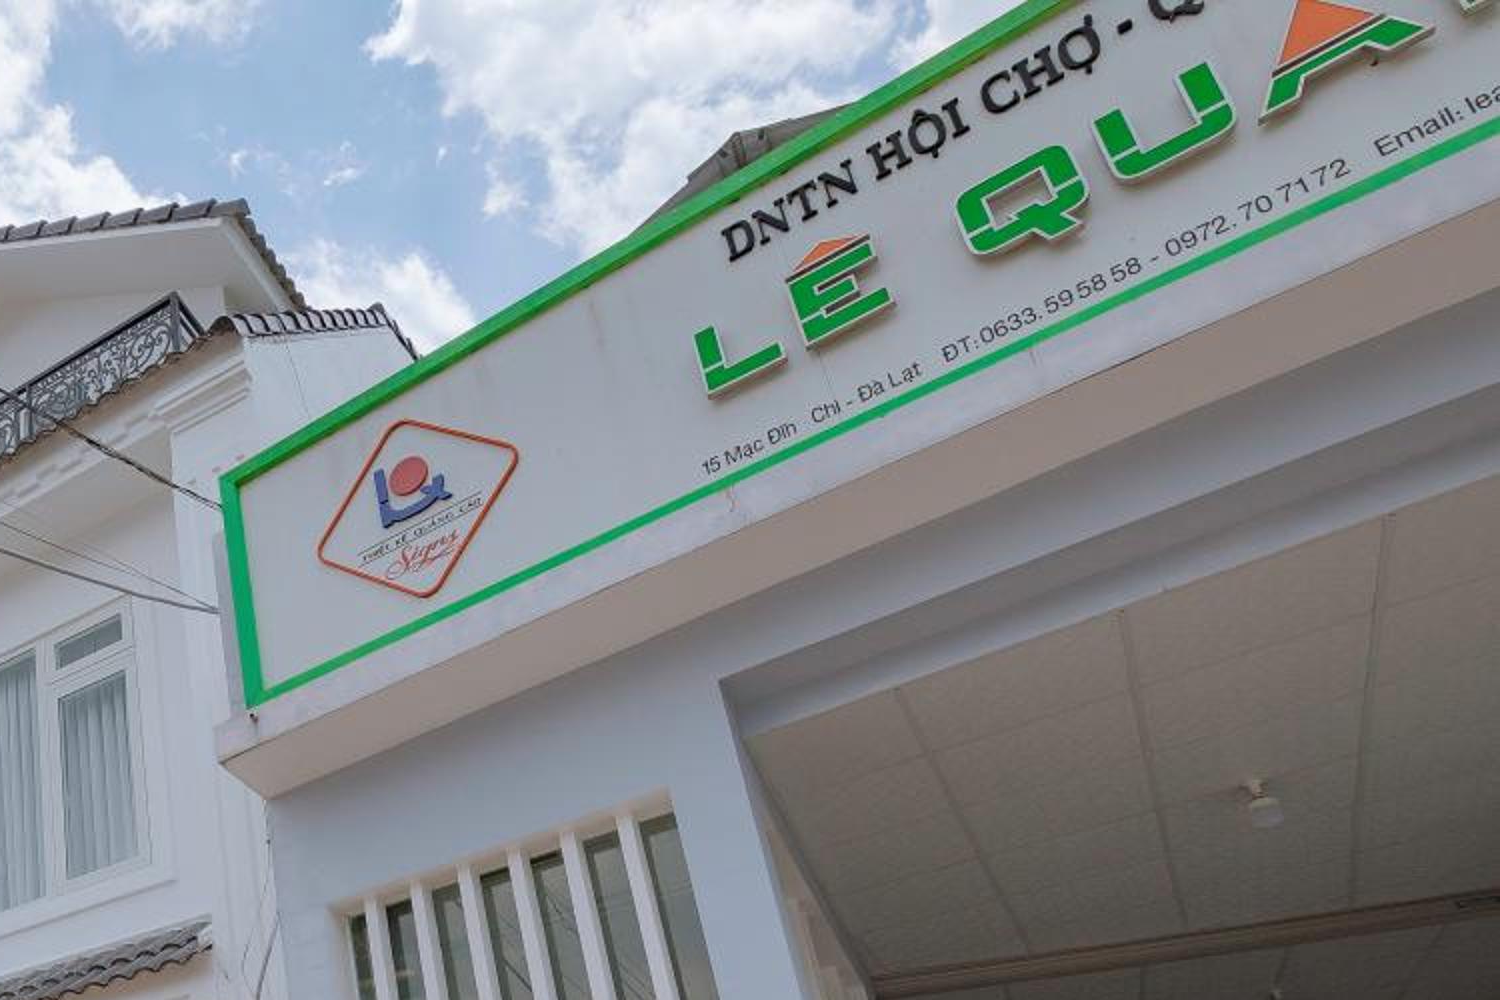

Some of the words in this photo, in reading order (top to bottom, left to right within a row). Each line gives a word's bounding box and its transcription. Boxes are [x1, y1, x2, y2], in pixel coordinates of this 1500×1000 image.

[693, 233, 897, 400] LÊ
[954, 0, 1500, 256] QUA
[702, 459, 721, 476] 15
[724, 439, 765, 466] Mạc
[857, 379, 886, 403] Đà
[888, 361, 922, 388] Lạt
[1374, 106, 1464, 157] Email:
[720, 158, 858, 262] DNTN
[866, 98, 971, 181] HỘI
[980, 14, 1102, 114] CHỢ
